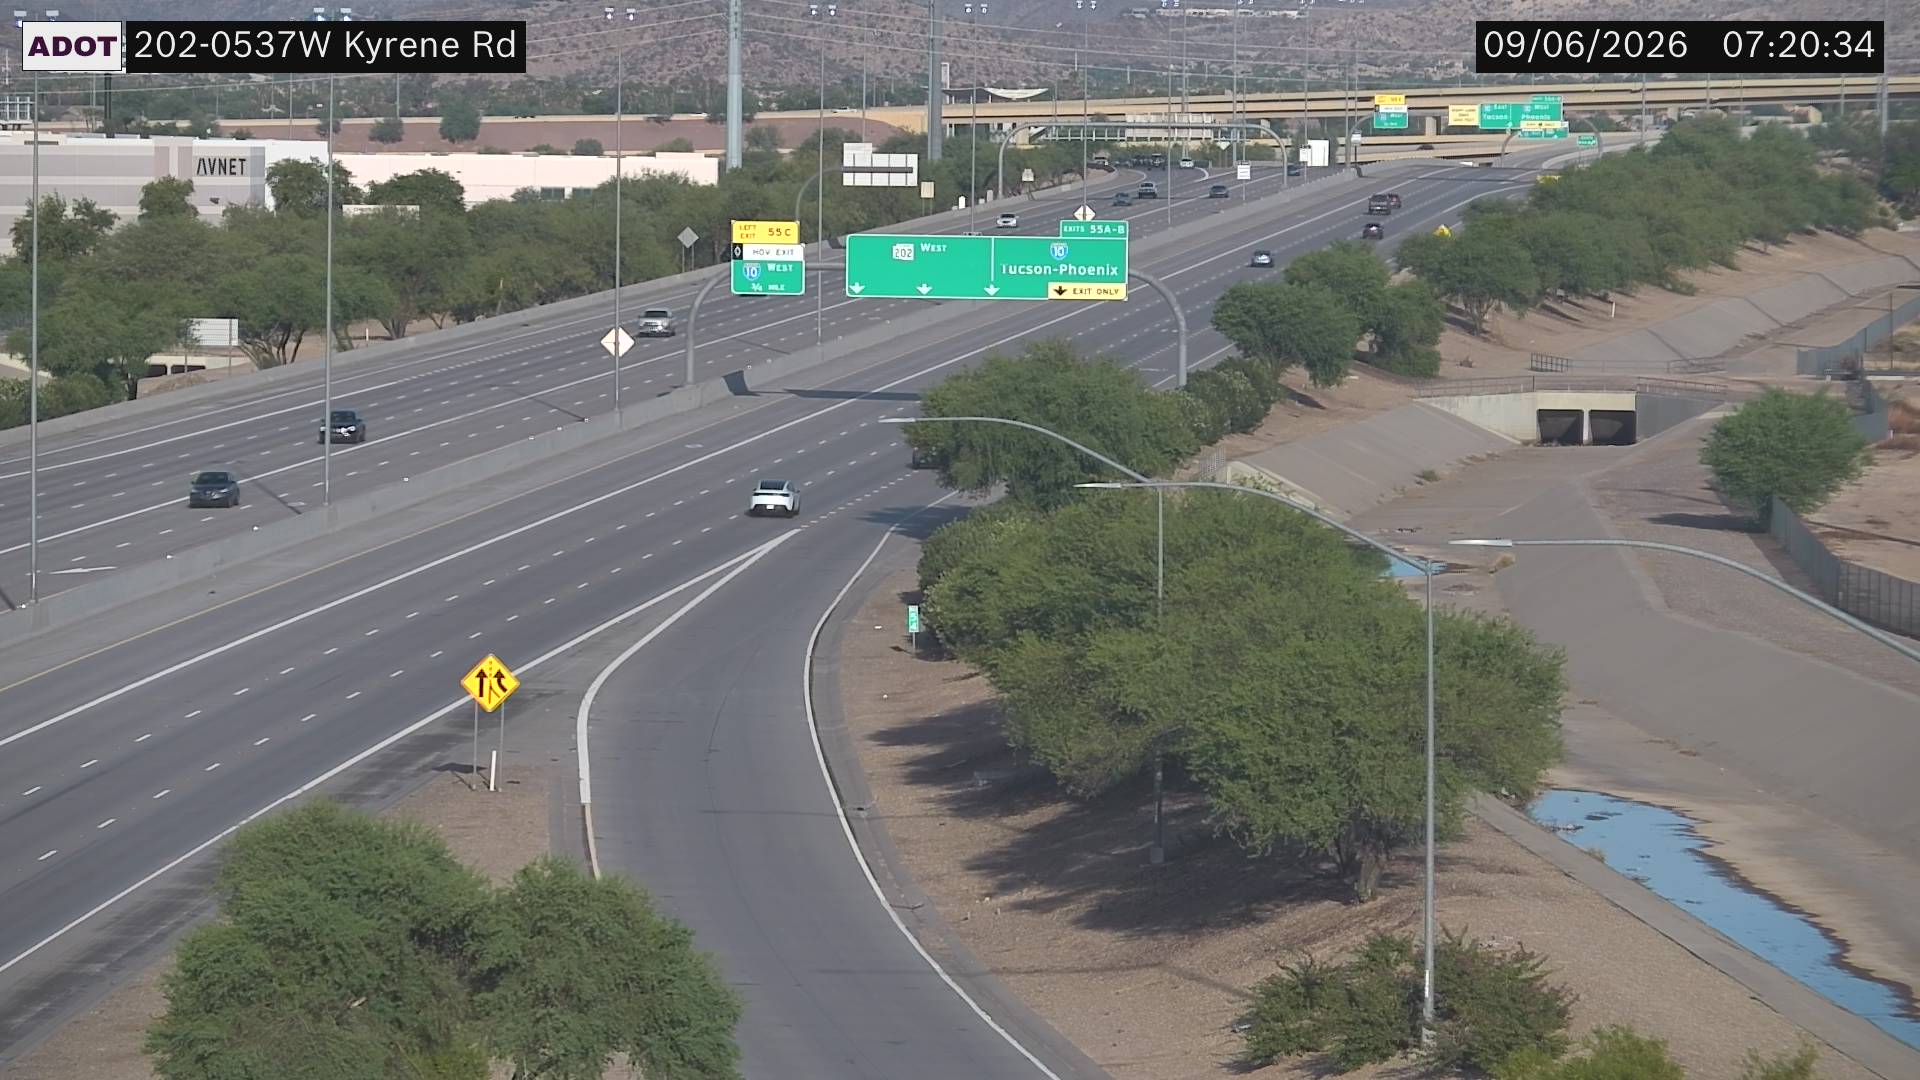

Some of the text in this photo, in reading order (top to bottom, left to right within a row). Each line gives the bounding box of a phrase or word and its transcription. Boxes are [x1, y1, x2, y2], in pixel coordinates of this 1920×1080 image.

[196, 157, 246, 176] AVNET
[894, 248, 913, 258] 202
[1053, 246, 1065, 257] 10
[745, 266, 758, 278] 10
[1000, 263, 1119, 276] Tucson-Phoenix
[1096, 288, 1120, 296] ONLY
